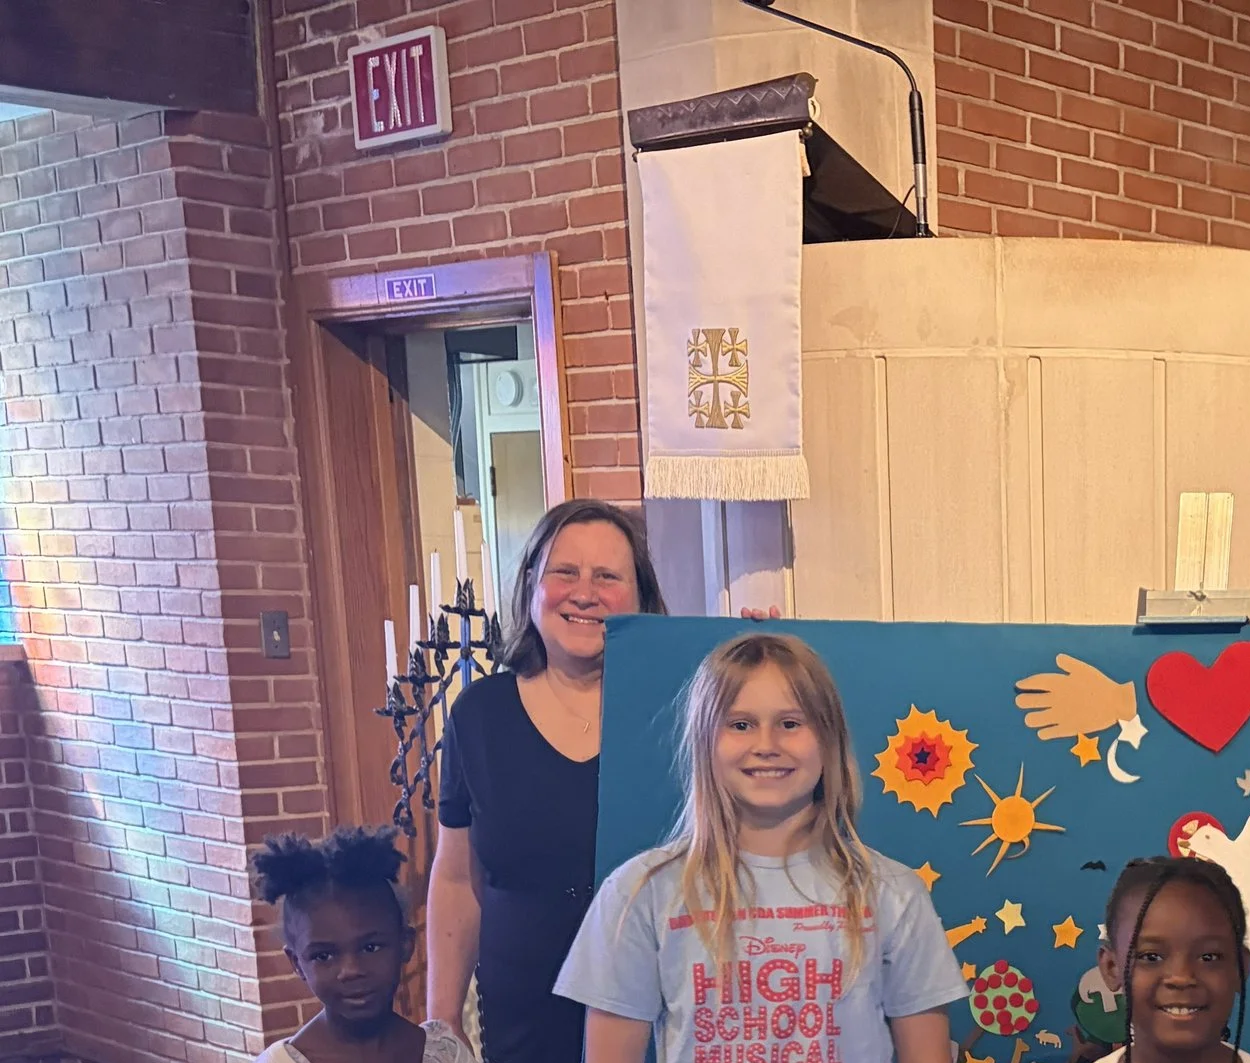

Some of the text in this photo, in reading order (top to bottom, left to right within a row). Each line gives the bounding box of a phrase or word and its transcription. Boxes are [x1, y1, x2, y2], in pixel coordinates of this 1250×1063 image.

[367, 44, 424, 132] EXIT
[392, 279, 427, 298] EXIT
[776, 904, 828, 919] SUMMER
[693, 958, 844, 1005] HIGH
[694, 1002, 841, 1042] SCHOOL
